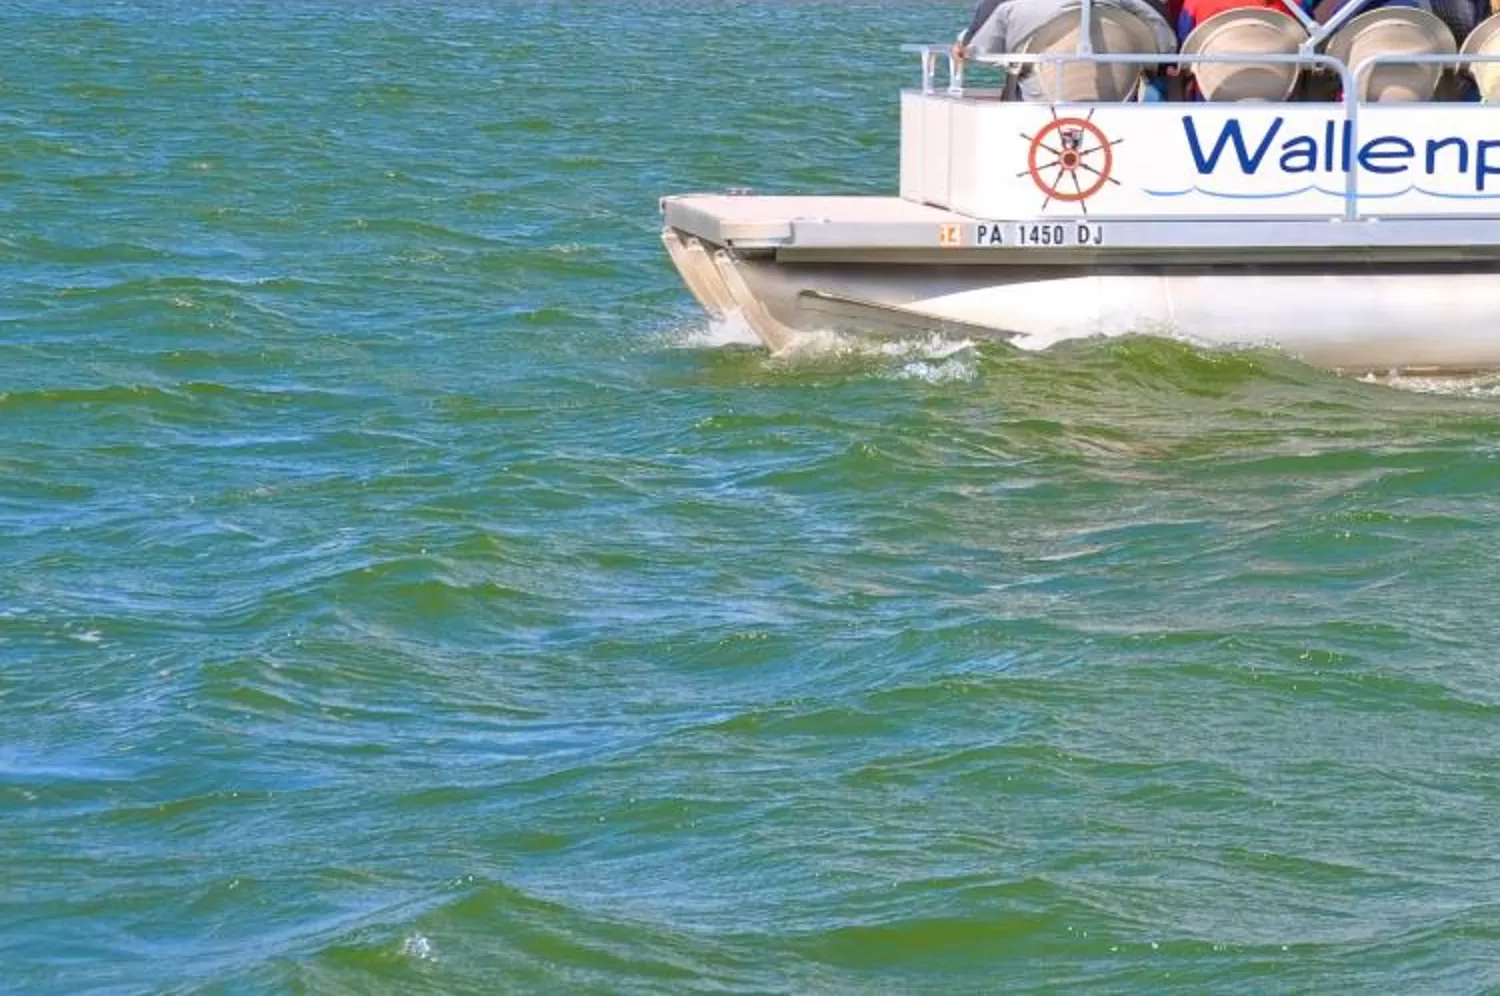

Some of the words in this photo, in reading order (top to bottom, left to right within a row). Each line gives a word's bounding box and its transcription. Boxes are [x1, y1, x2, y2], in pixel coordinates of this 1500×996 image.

[976, 224, 1003, 245] PA
[1019, 225, 1065, 245] 1450
[1077, 225, 1103, 245] DJ
